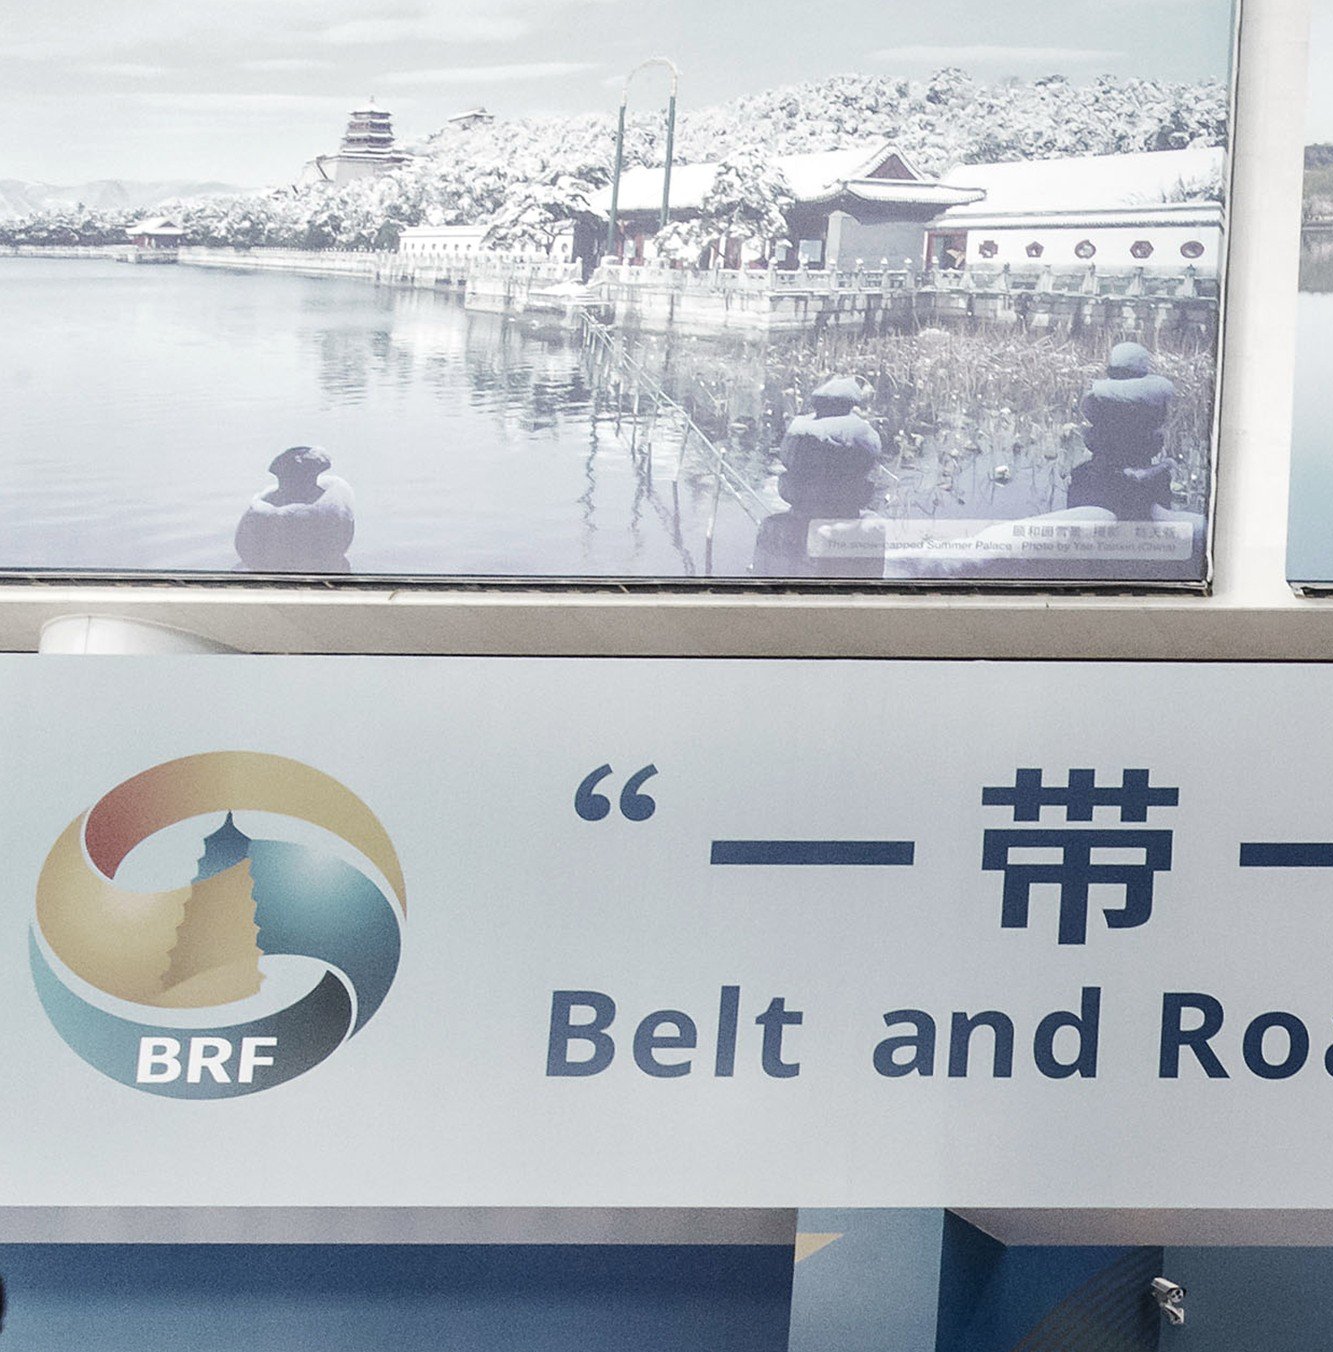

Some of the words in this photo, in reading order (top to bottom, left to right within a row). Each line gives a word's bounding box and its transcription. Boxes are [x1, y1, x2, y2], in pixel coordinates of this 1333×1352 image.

[925, 541, 973, 551] Summer
[975, 541, 1013, 551] Palace
[547, 985, 803, 1078] Belt
[873, 985, 1102, 1080] and
[137, 1037, 278, 1083] BRF
